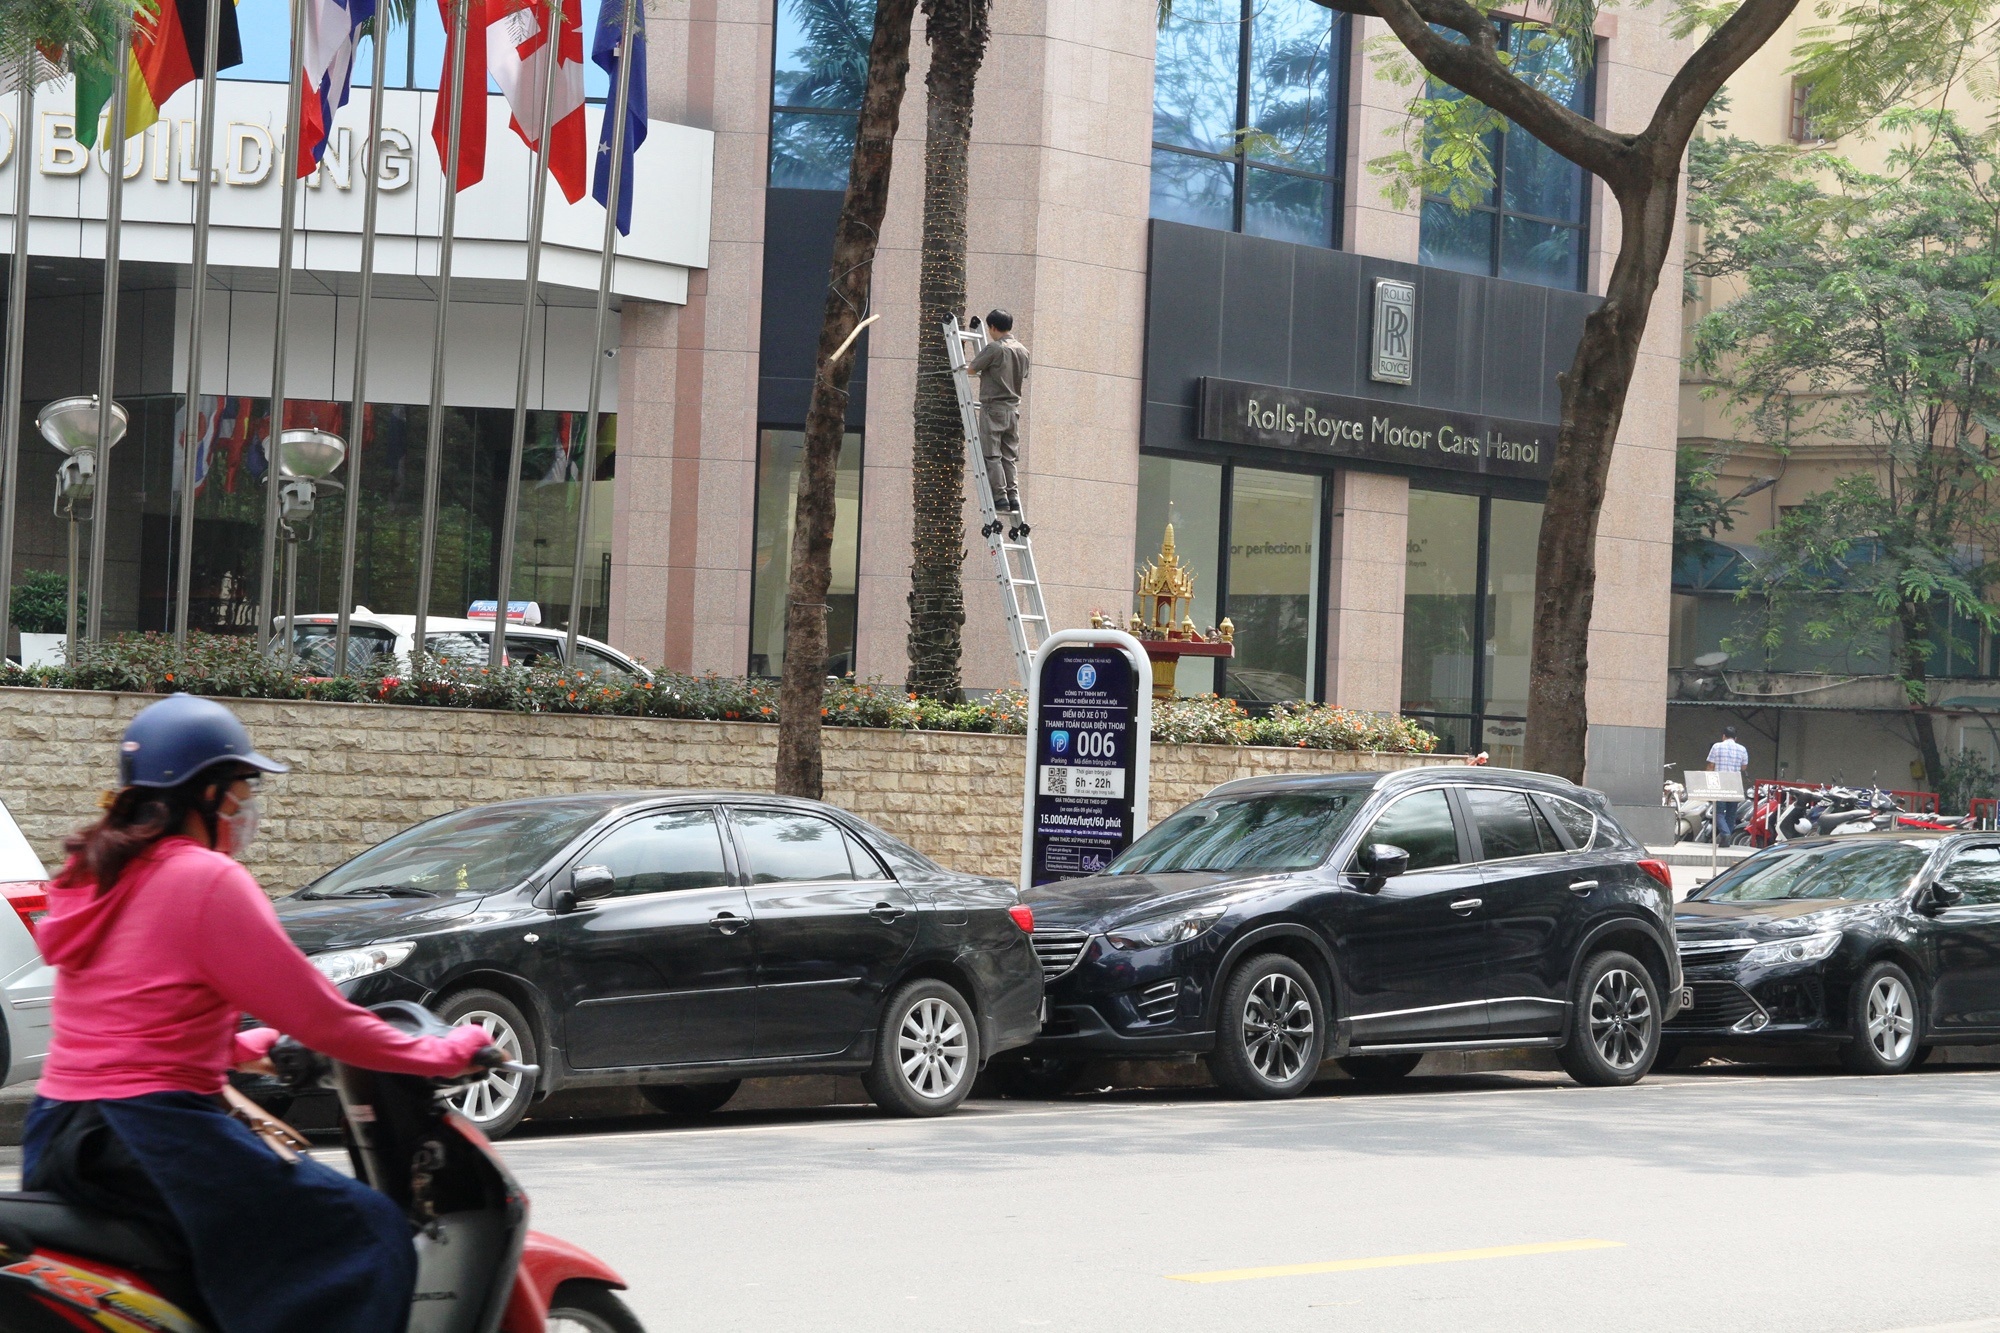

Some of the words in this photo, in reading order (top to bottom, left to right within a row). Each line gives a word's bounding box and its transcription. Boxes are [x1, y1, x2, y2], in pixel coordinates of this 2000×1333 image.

[40, 111, 413, 190] BUILDNG
[1384, 288, 1411, 302] ROLLS
[1381, 360, 1408, 374] ROYCE
[1247, 399, 1364, 446] Rolls-Royce
[1371, 416, 1433, 450] Motor
[1438, 425, 1480, 456] Cars
[1486, 431, 1539, 463] Hanoi
[1246, 541, 1302, 558] perfection
[1062, 708, 1076, 718] ĐIỂM
[1086, 711, 1094, 719] XE
[1094, 710, 1099, 719] Ô
[1100, 710, 1108, 719] TÔ
[1045, 720, 1064, 728] THANH
[1065, 719, 1080, 728] TOÁN
[1081, 721, 1093, 729] QUA
[1093, 721, 1107, 731] ĐIỆN
[1108, 722, 1126, 732] THOẠI
[1077, 731, 1115, 758] 006
[1050, 757, 1067, 765] iParking
[1075, 777, 1086, 787] 6h
[1095, 778, 1111, 788] 22h
[1040, 814, 1104, 828] 15.000đ/xe/lượt/60
[1105, 817, 1121, 829] phút
